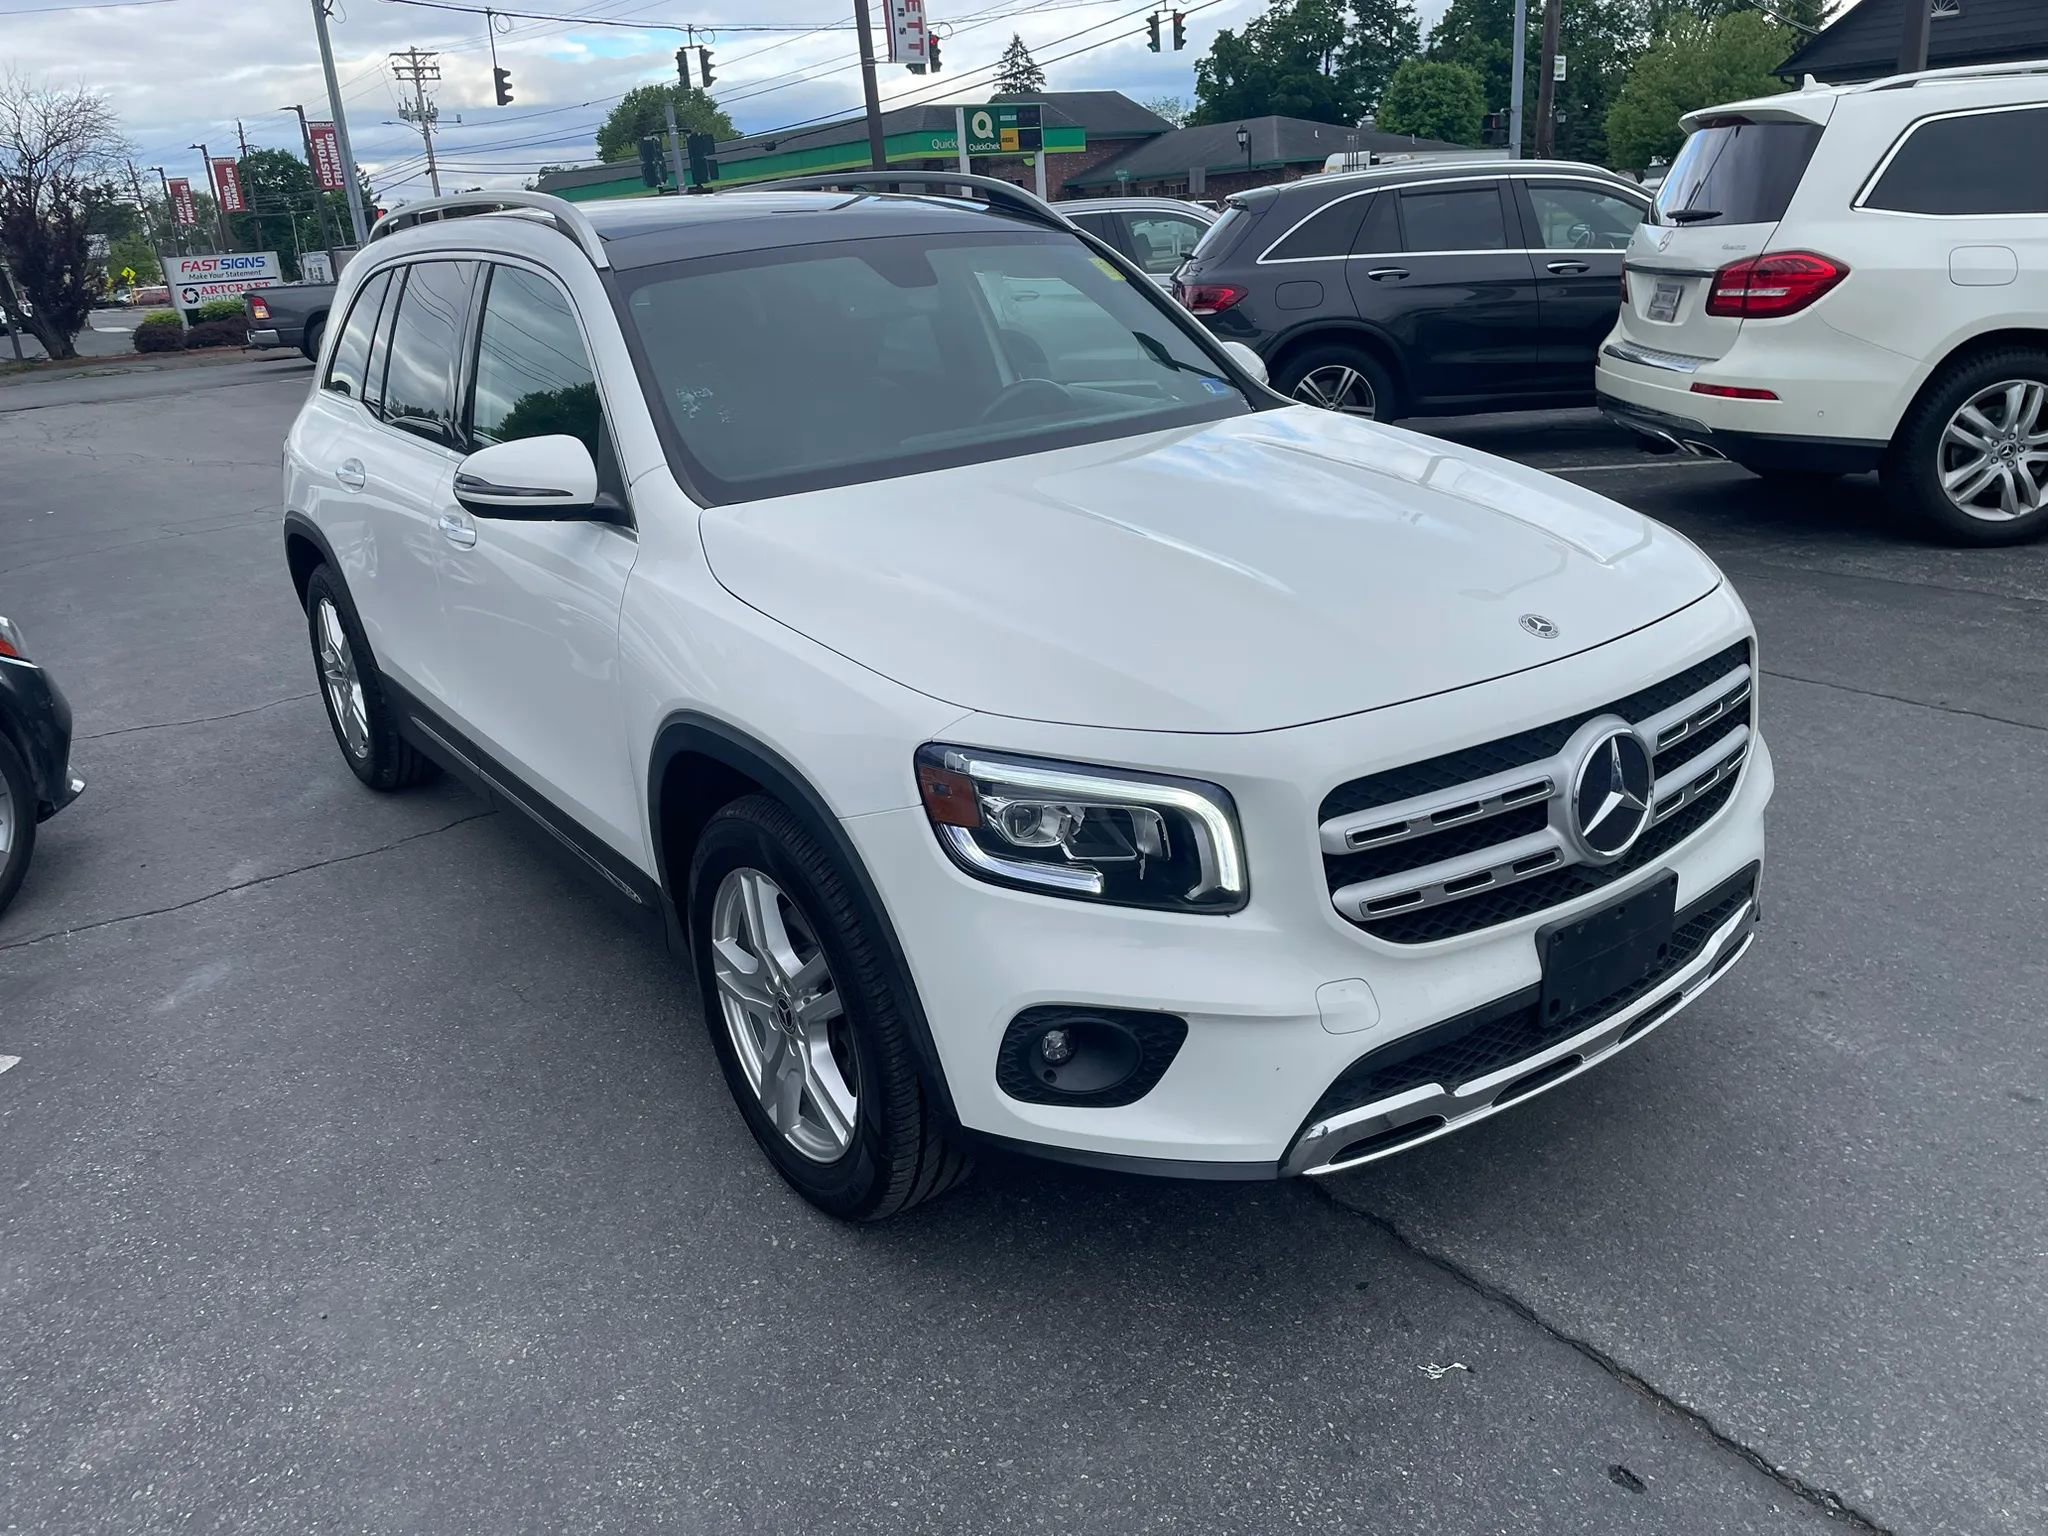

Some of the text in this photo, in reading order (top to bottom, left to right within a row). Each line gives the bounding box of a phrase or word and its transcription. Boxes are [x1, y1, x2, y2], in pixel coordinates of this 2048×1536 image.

[971, 111, 995, 139] Q
[325, 133, 344, 186] FRAMING
[968, 142, 1001, 152] QuickChek
[315, 138, 333, 187] CUSTOM
[222, 185, 234, 210] VIDEO
[225, 167, 241, 210] TRANSFER
[181, 256, 266, 273] FASTSIGNS
[188, 269, 262, 280] Make Your Statement
